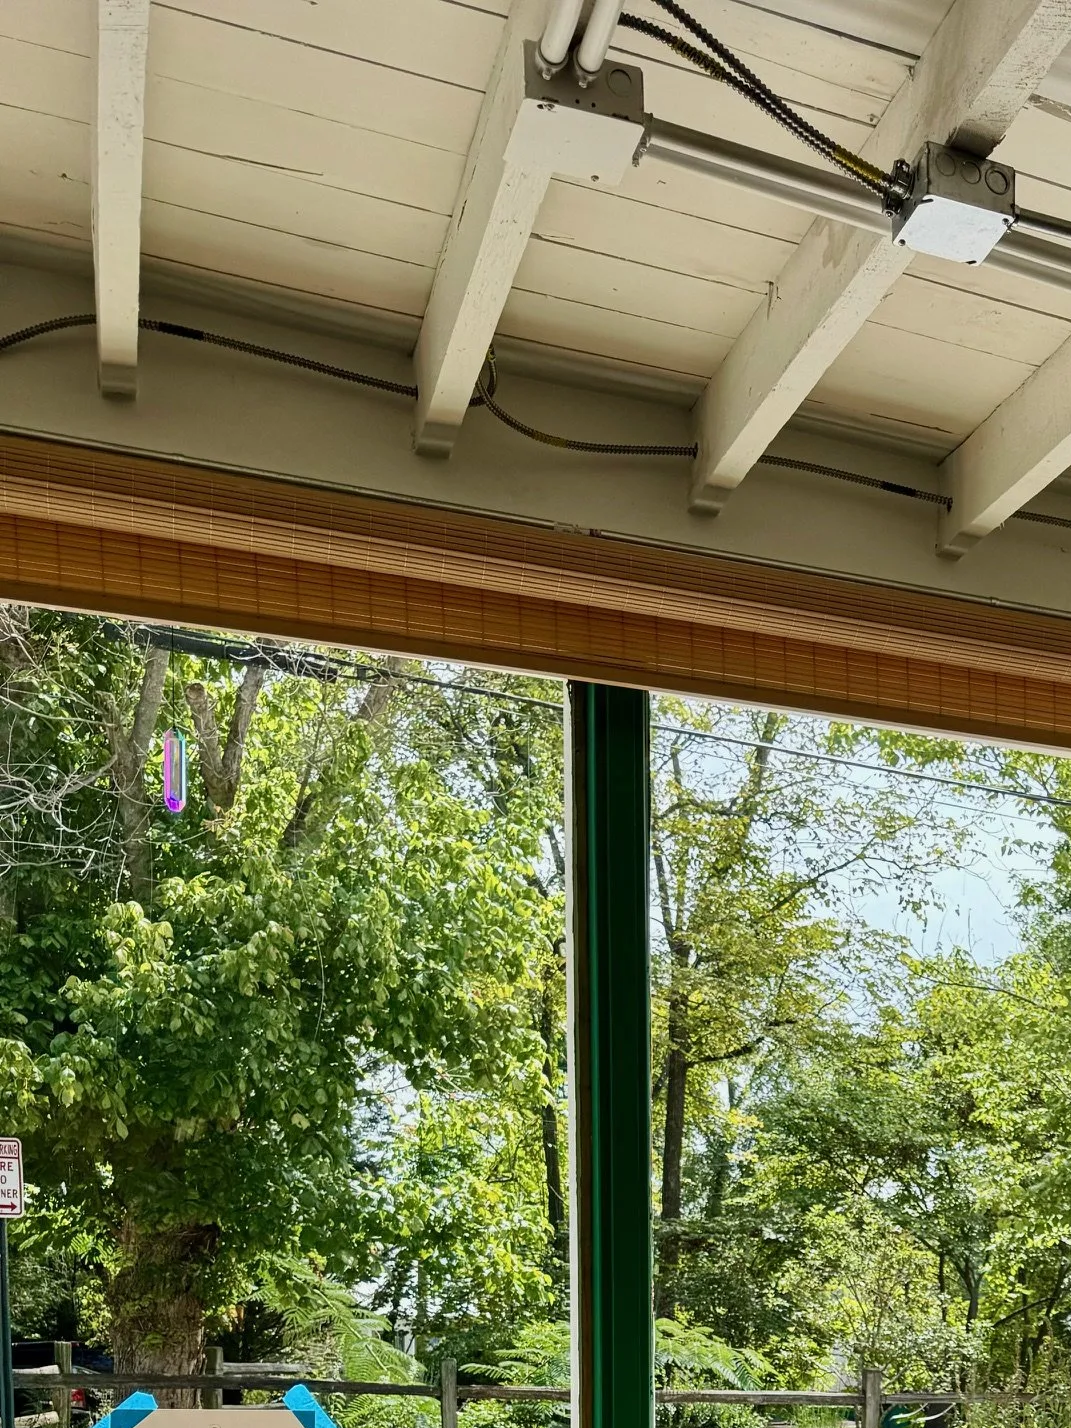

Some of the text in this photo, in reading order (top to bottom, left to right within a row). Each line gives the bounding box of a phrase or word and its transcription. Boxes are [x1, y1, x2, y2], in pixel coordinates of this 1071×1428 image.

[0, 1145, 17, 1156] RKING
[0, 1162, 14, 1171] RE
[0, 1188, 18, 1199] NER
